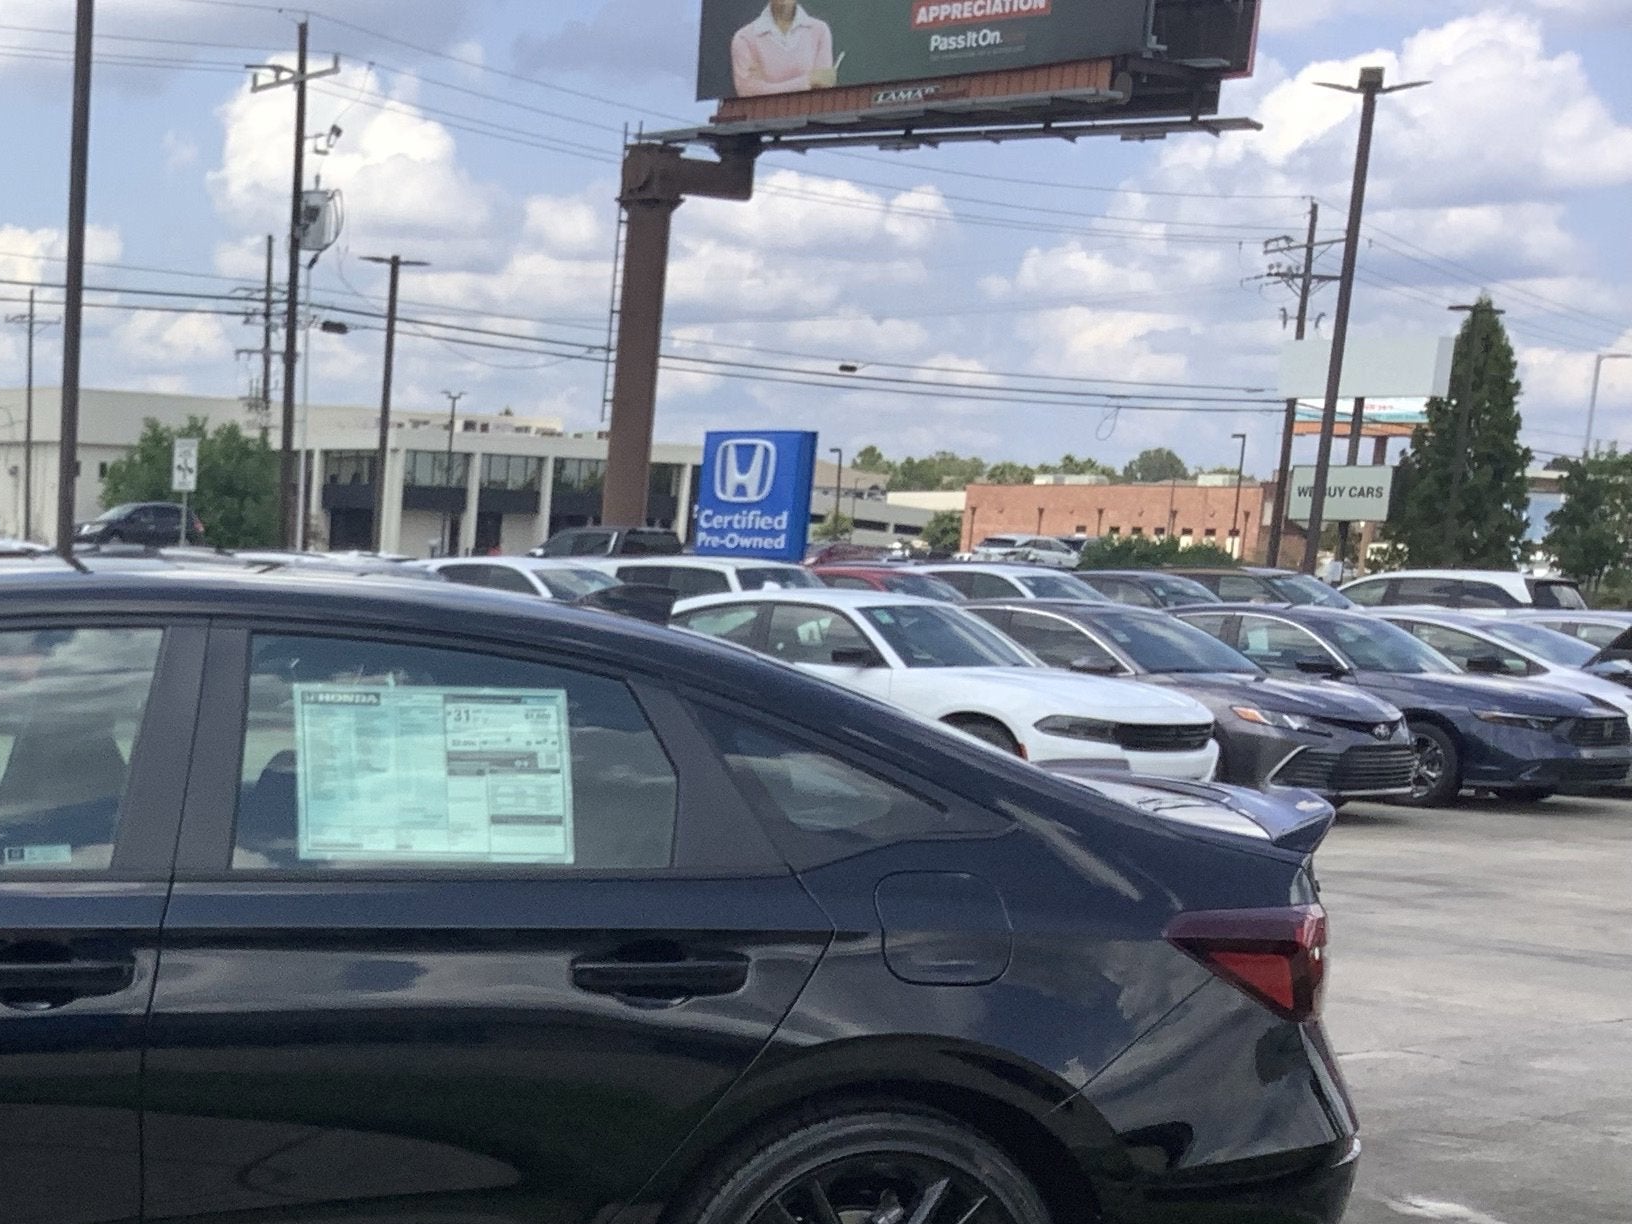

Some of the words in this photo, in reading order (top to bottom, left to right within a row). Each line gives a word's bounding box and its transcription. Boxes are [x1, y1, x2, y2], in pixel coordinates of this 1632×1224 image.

[915, 0, 1046, 24] APPRECIATION
[1348, 485, 1384, 498] CARS
[700, 509, 789, 531] Certified
[697, 531, 786, 549] Pre-Owned
[317, 693, 378, 704] HONDA
